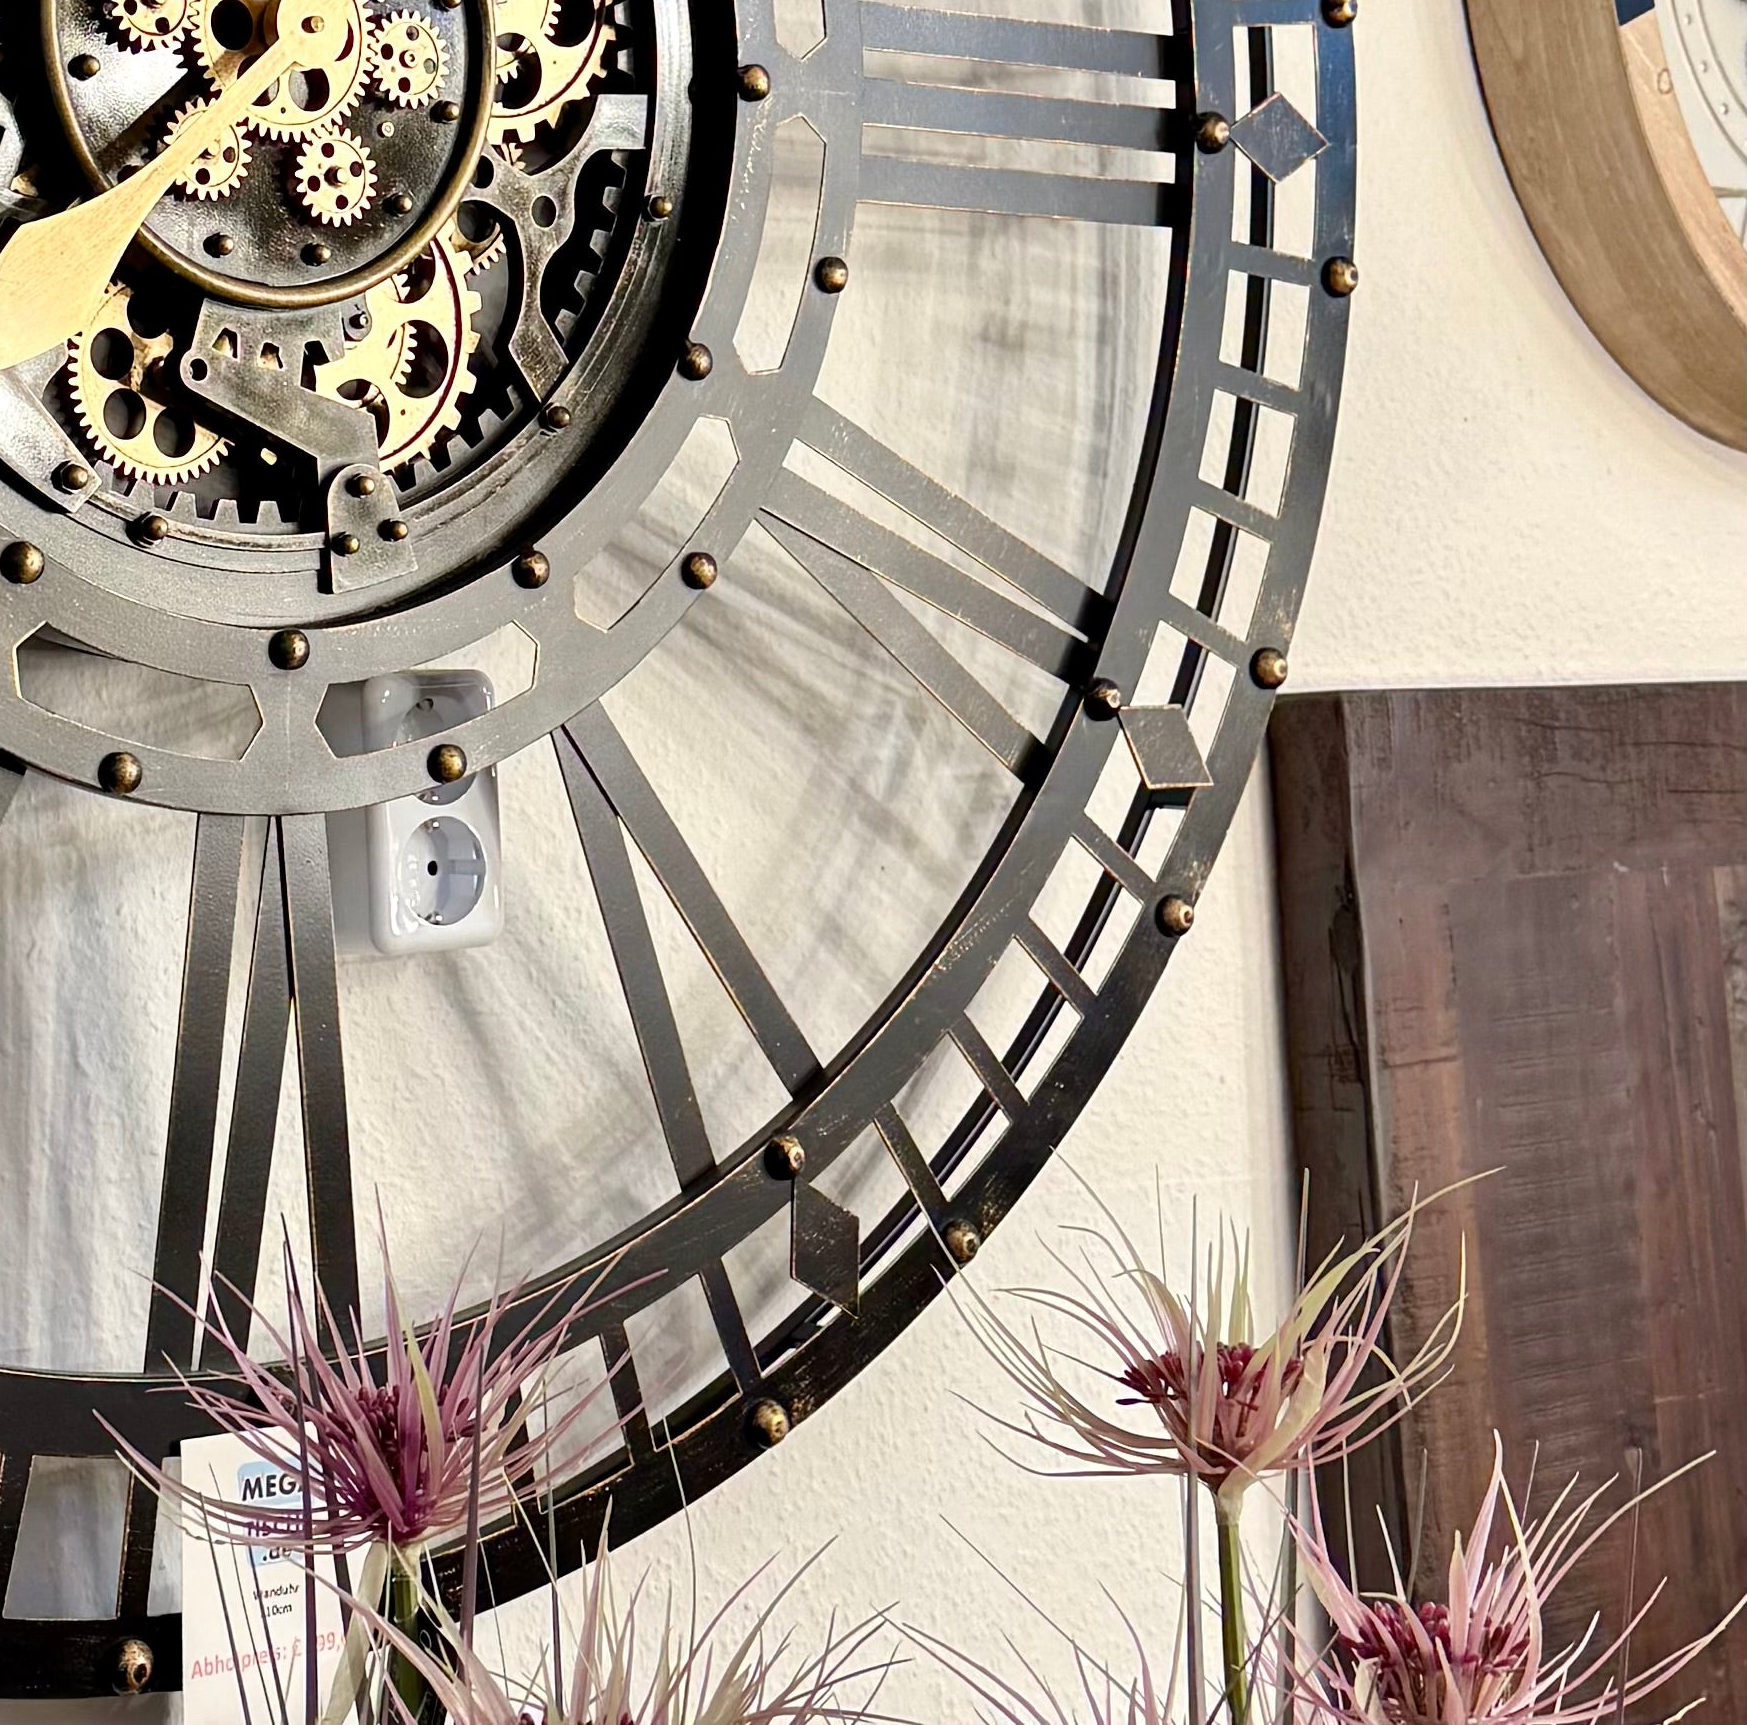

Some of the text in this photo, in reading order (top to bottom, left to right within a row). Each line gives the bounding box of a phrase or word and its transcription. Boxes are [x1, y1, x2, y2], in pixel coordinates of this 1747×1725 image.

[241, 1473, 304, 1501] MEG
[261, 1603, 293, 1618] 10cm
[190, 1645, 287, 1680] Abhopres:
